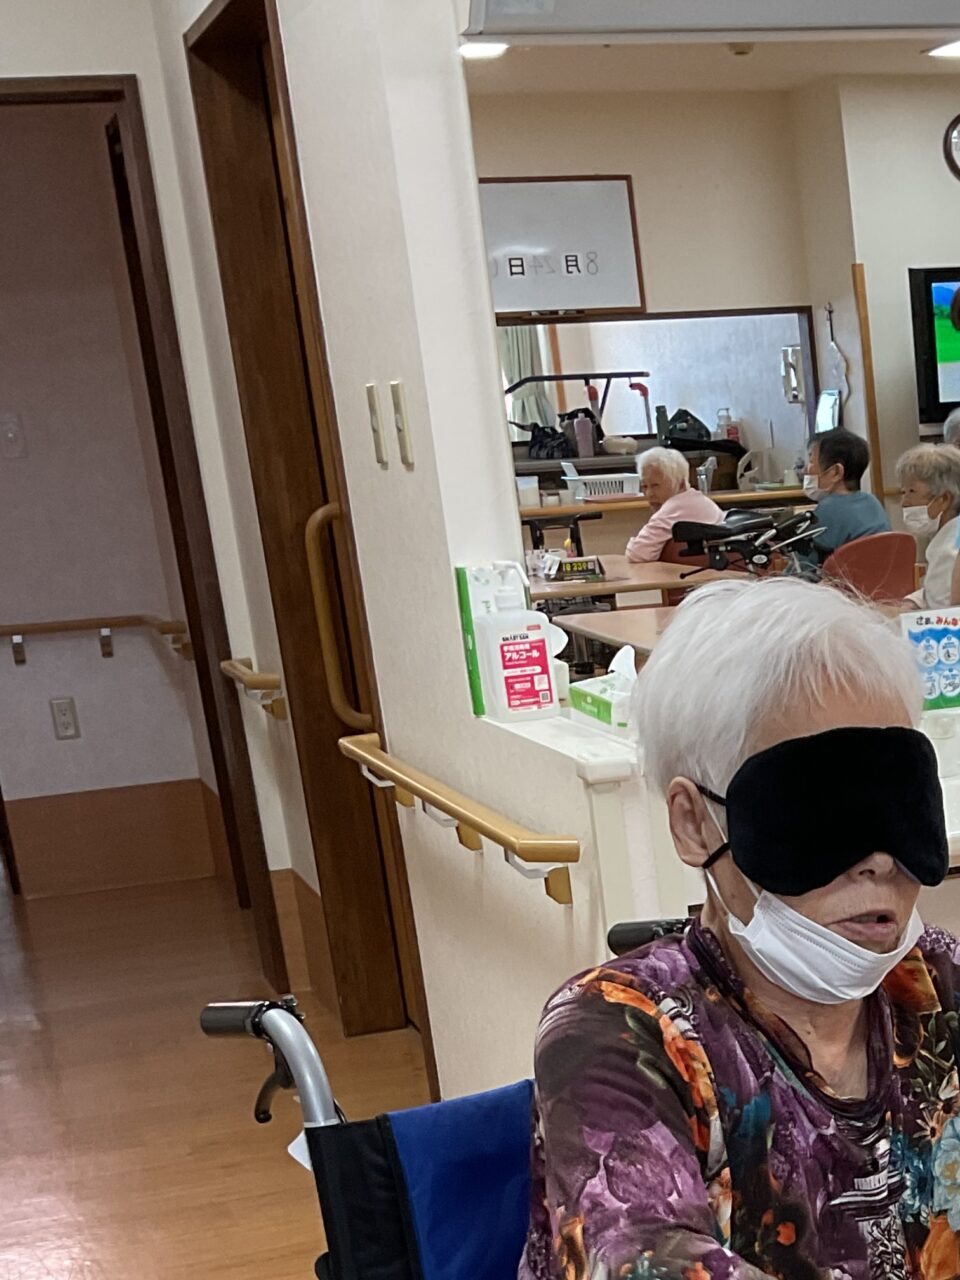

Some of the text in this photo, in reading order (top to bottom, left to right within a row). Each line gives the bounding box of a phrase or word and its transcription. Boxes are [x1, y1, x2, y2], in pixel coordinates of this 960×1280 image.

[504, 649, 541, 661] アルコール
